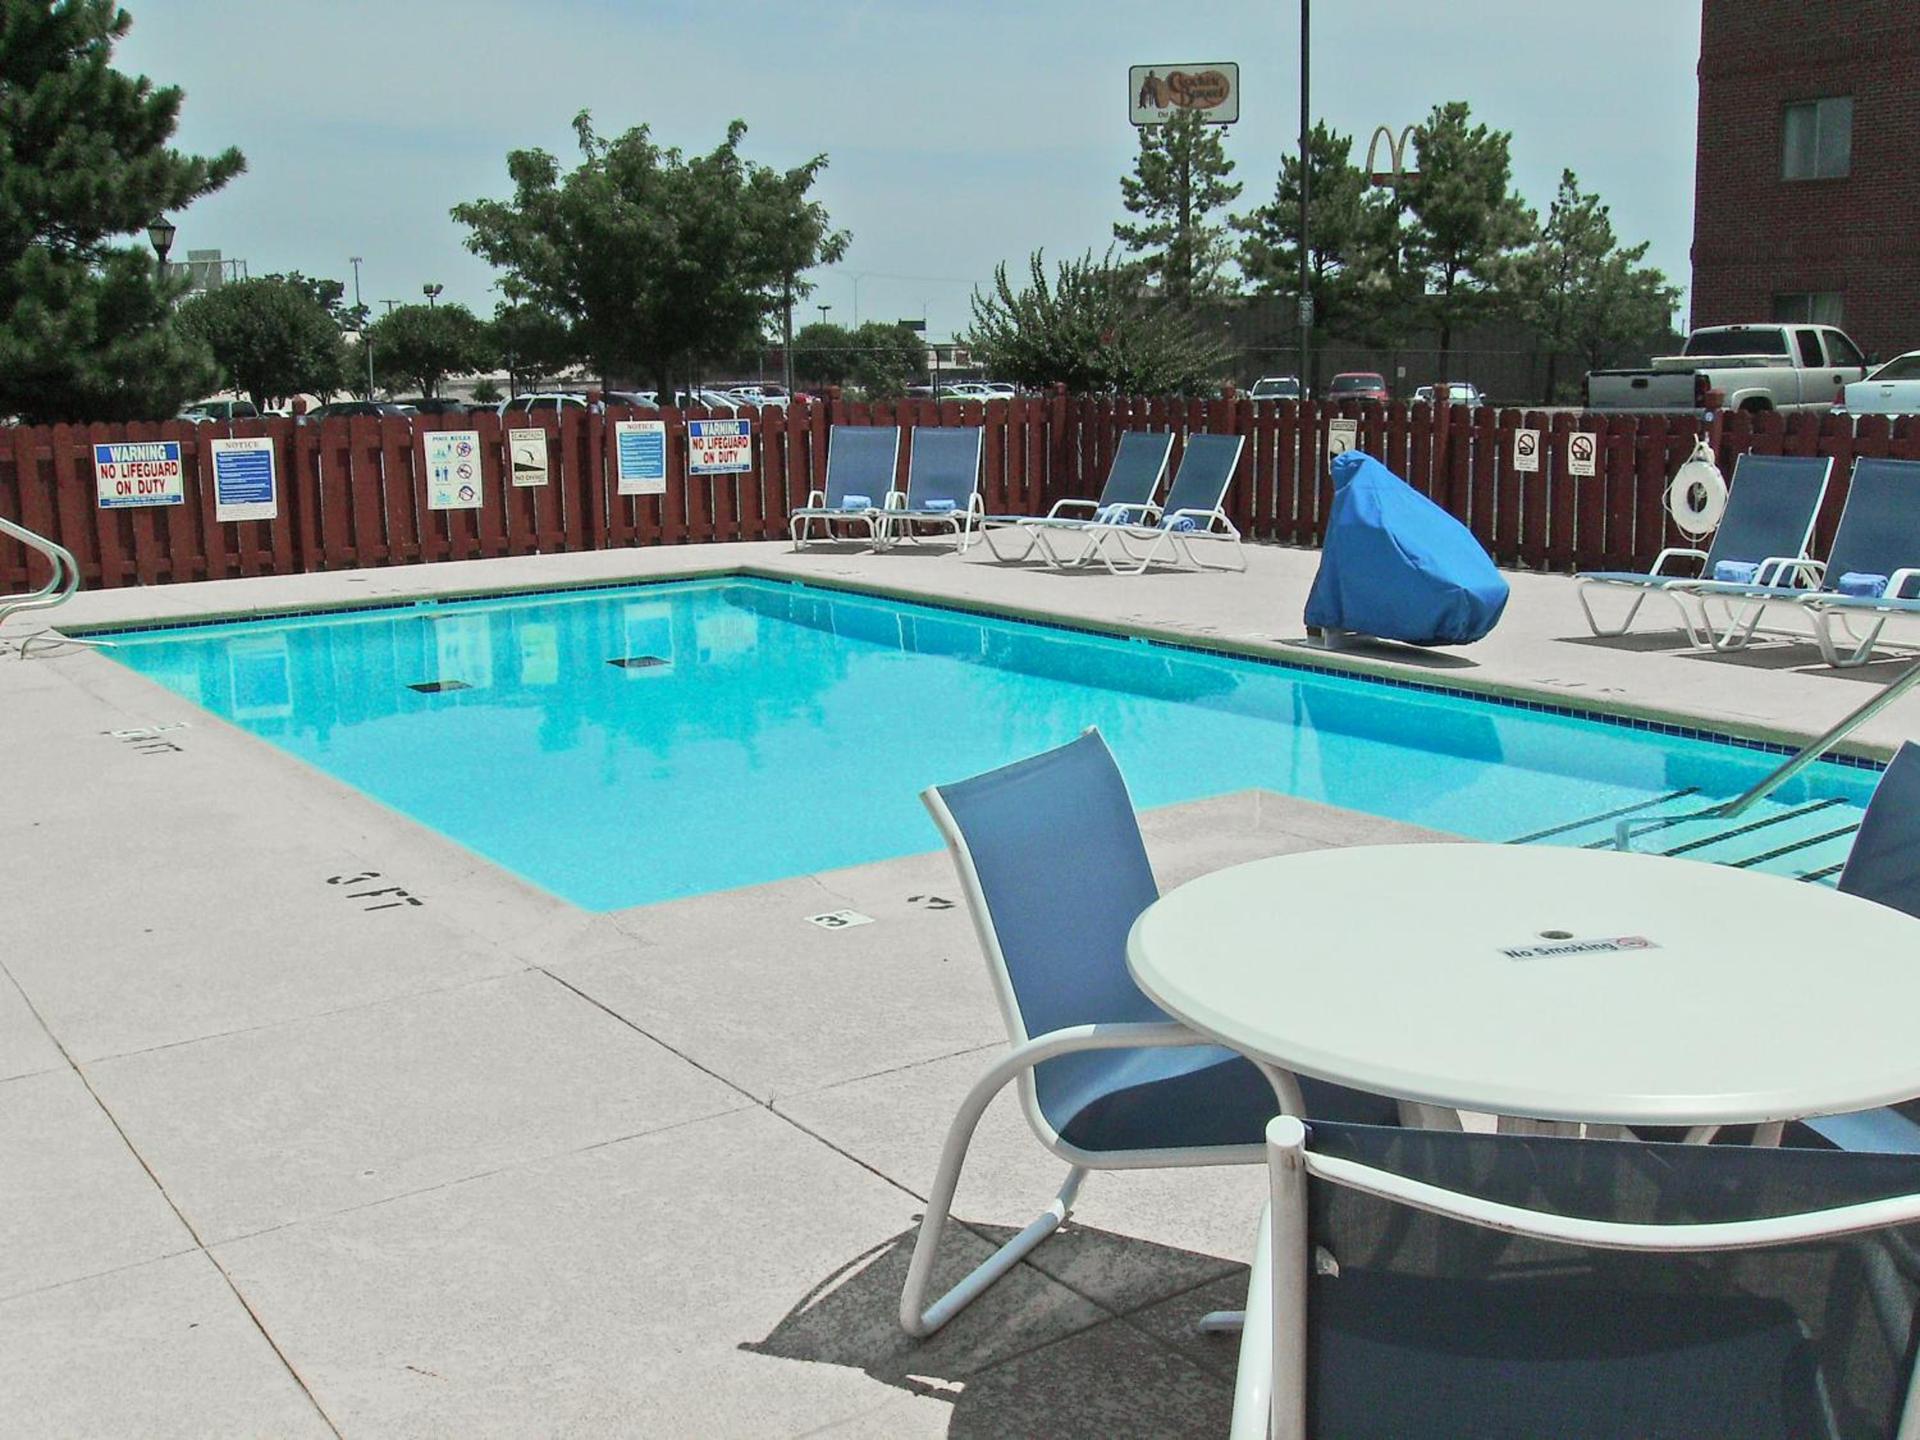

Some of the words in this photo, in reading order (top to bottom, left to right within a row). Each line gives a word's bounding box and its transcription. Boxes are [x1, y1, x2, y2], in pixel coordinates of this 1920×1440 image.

[700, 422, 740, 436] WARNING
[692, 437, 705, 450] NO
[707, 436, 749, 450] LIFEGUARD
[109, 445, 166, 462] WARNING
[703, 451, 715, 464] ON
[718, 450, 738, 463] DUTY
[100, 464, 116, 479] NO
[121, 461, 178, 478] LIFEGUARD
[116, 481, 132, 495] ON
[137, 479, 166, 494] DUTY
[815, 915, 848, 927] 3
[1504, 950, 1533, 959] No
[1533, 942, 1619, 956] Smoking
